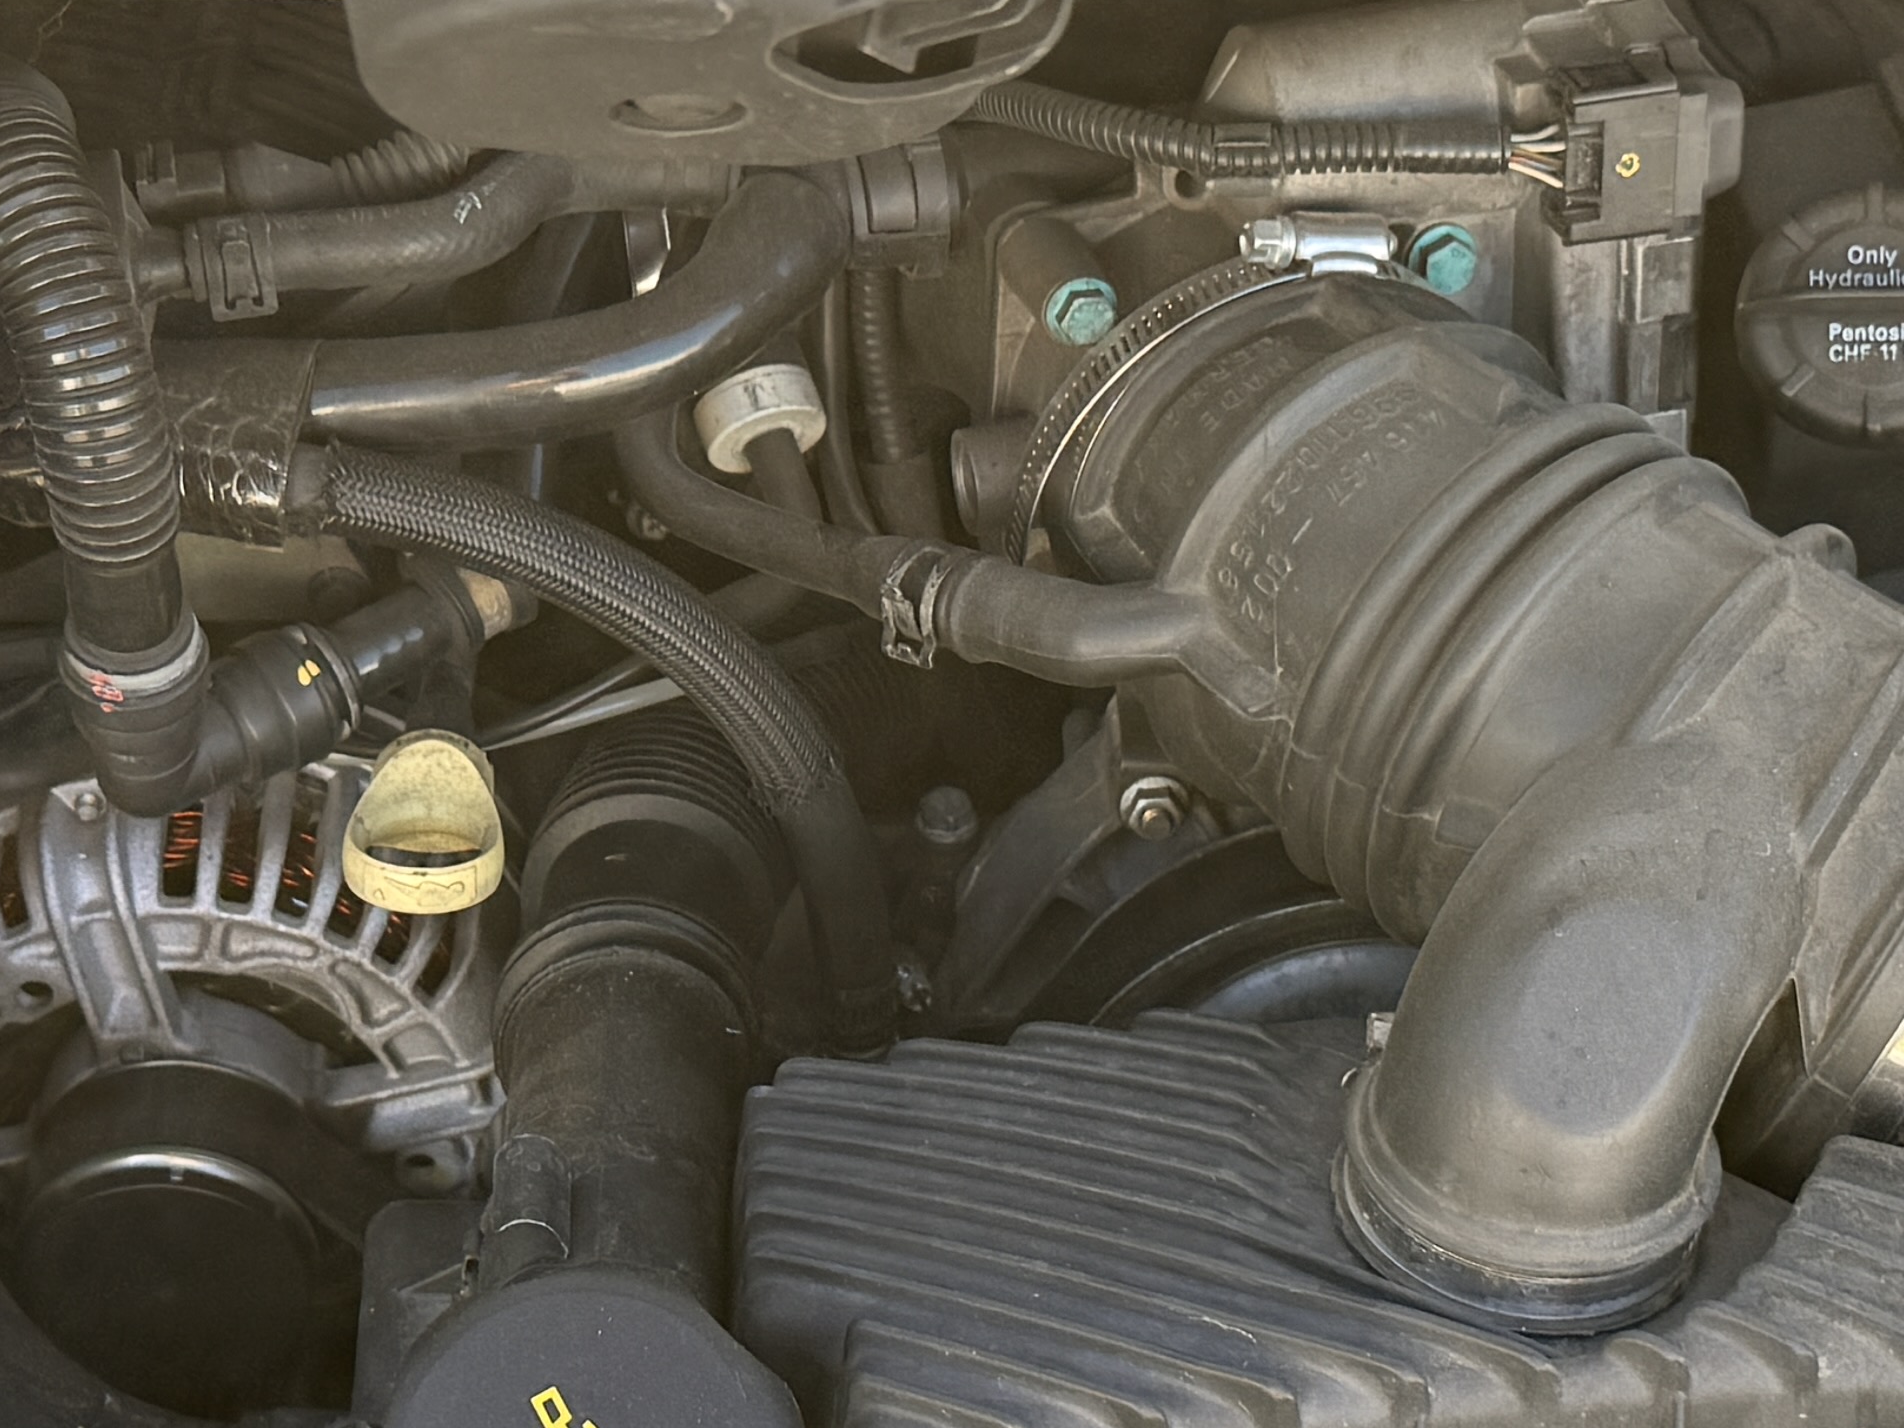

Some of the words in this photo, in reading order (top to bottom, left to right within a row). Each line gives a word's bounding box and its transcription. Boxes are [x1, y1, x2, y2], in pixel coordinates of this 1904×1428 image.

[1847, 244, 1898, 268] Only
[1828, 344, 1870, 362] CHF
[1879, 343, 1898, 361] 11
